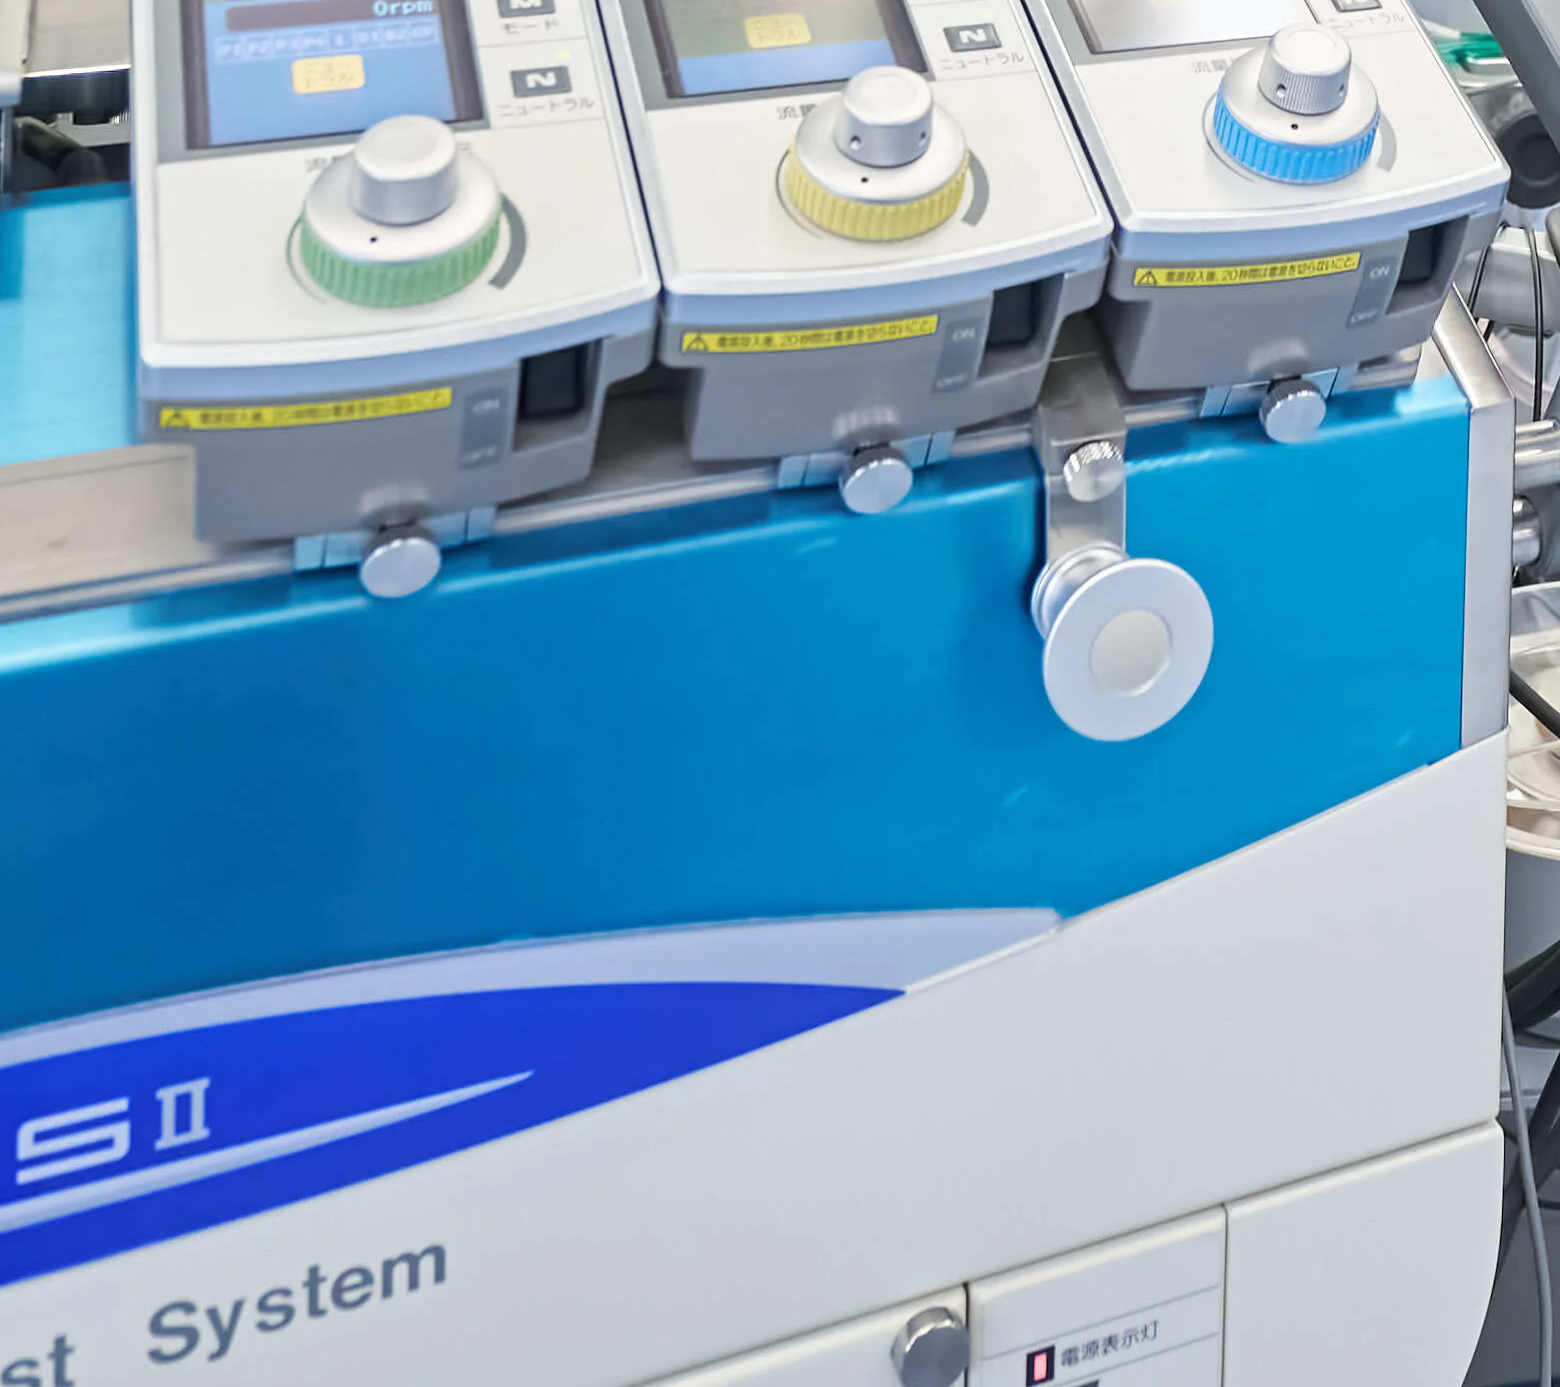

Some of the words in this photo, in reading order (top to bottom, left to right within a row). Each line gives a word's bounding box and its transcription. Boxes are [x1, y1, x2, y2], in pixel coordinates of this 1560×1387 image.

[503, 18, 559, 34] モード
[1327, 11, 1405, 30] ニュートラル
[939, 51, 1025, 72] ニュートラル
[498, 95, 595, 118] ニュートラル
[1369, 265, 1391, 278] ON
[951, 327, 976, 342] ON
[147, 1240, 449, 1364] System
[1060, 1319, 1159, 1368] 電源表示灯
